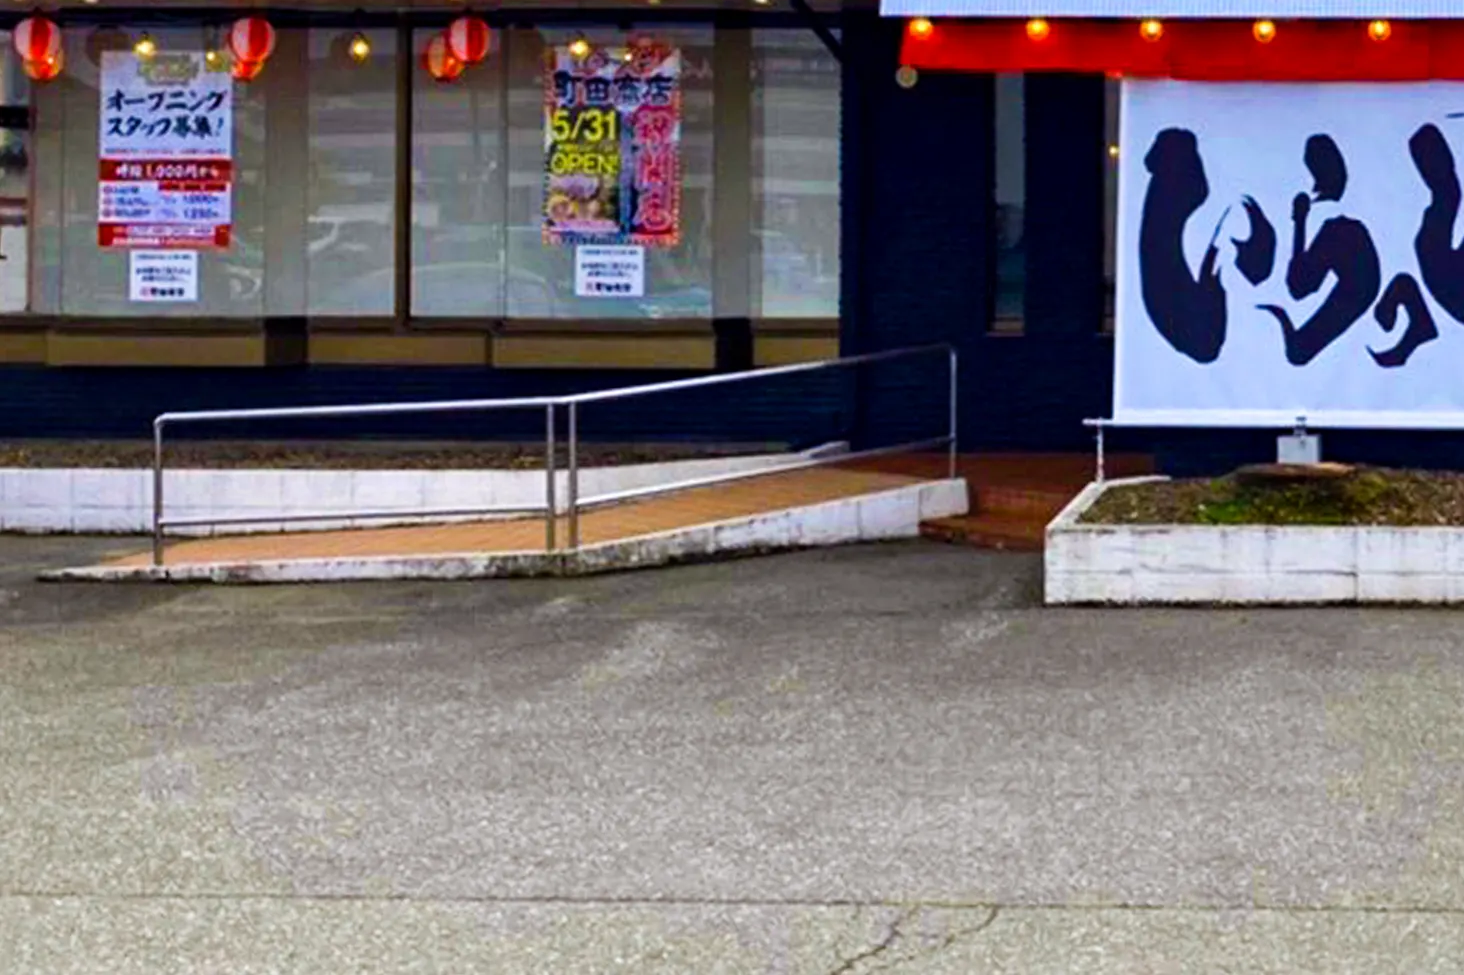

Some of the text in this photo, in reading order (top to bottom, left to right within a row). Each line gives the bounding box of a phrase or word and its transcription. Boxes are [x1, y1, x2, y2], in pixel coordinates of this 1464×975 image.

[107, 88, 228, 112] オープニング
[552, 108, 617, 142] 5/31
